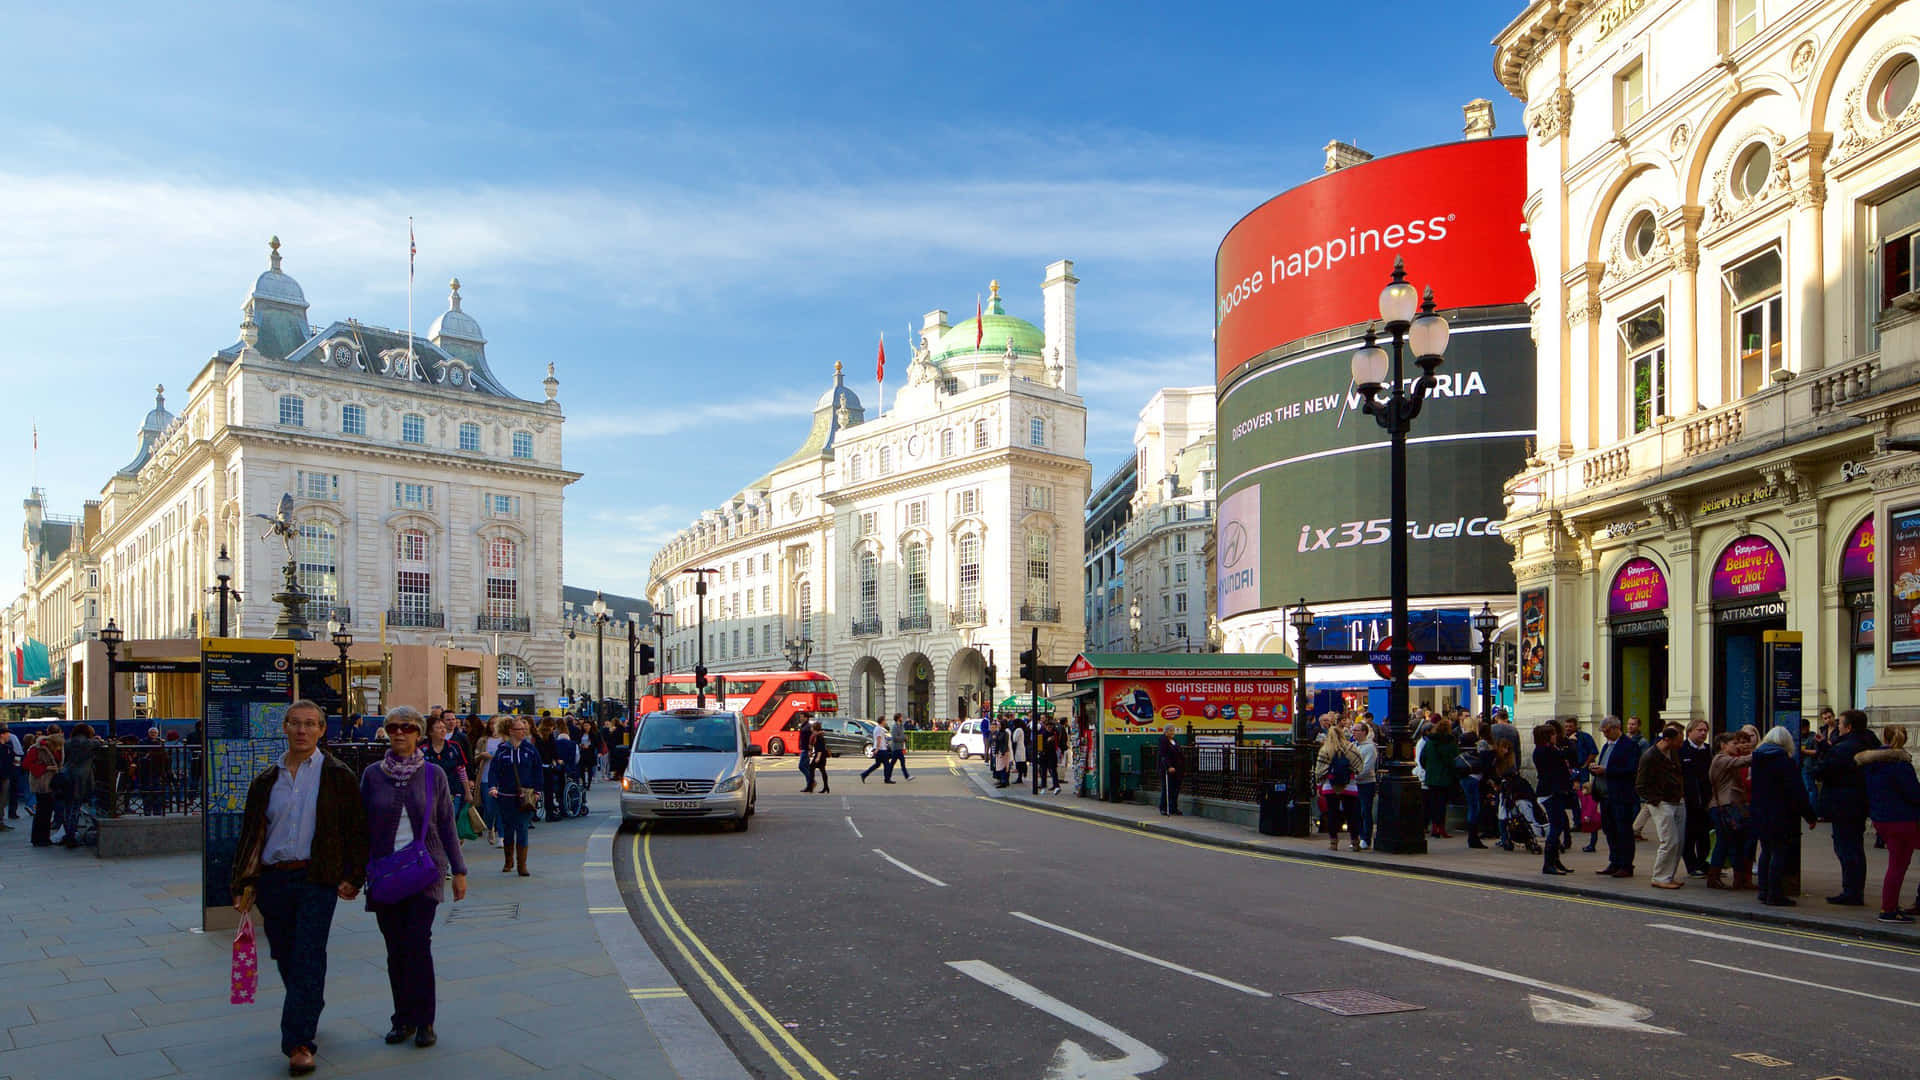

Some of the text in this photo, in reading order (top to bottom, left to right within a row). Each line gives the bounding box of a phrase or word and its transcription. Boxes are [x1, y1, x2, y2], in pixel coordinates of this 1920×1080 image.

[1232, 411, 1273, 440] DISCOVER
[1275, 403, 1301, 421] THE
[1304, 393, 1340, 414] NEW
[1701, 486, 1773, 513] Believe It or Not!
[1297, 518, 1392, 552] ix35
[1725, 550, 1774, 571] Believe It
[1619, 572, 1659, 590] Believe It
[1731, 566, 1767, 585] or Not!
[1624, 586, 1653, 602] or Not!
[1738, 583, 1760, 594] LONDON
[1630, 601, 1648, 610] LONDON
[1722, 602, 1785, 621] ATTRACTION
[1617, 617, 1669, 634] ATTRACTION
[1165, 683, 1289, 693] SIGHTSEEING BUS TOURS
